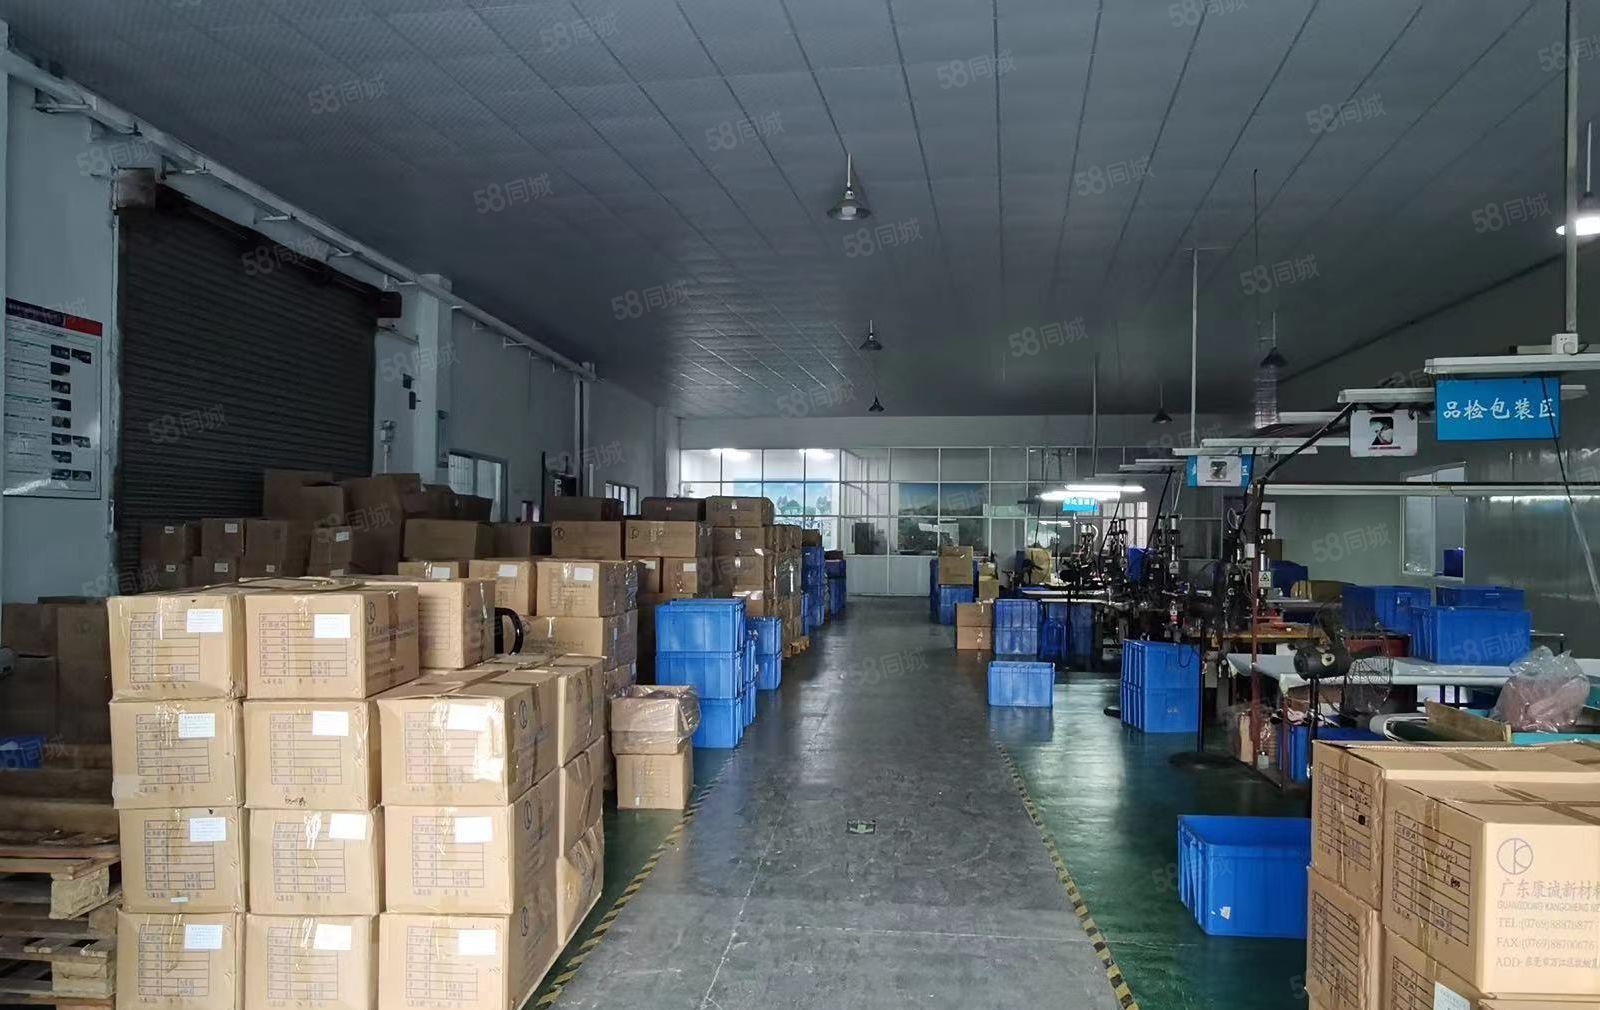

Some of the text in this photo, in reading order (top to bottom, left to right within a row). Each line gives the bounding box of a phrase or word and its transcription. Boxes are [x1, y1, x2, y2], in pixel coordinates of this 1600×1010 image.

[1443, 397, 1556, 421] 品检包装区
